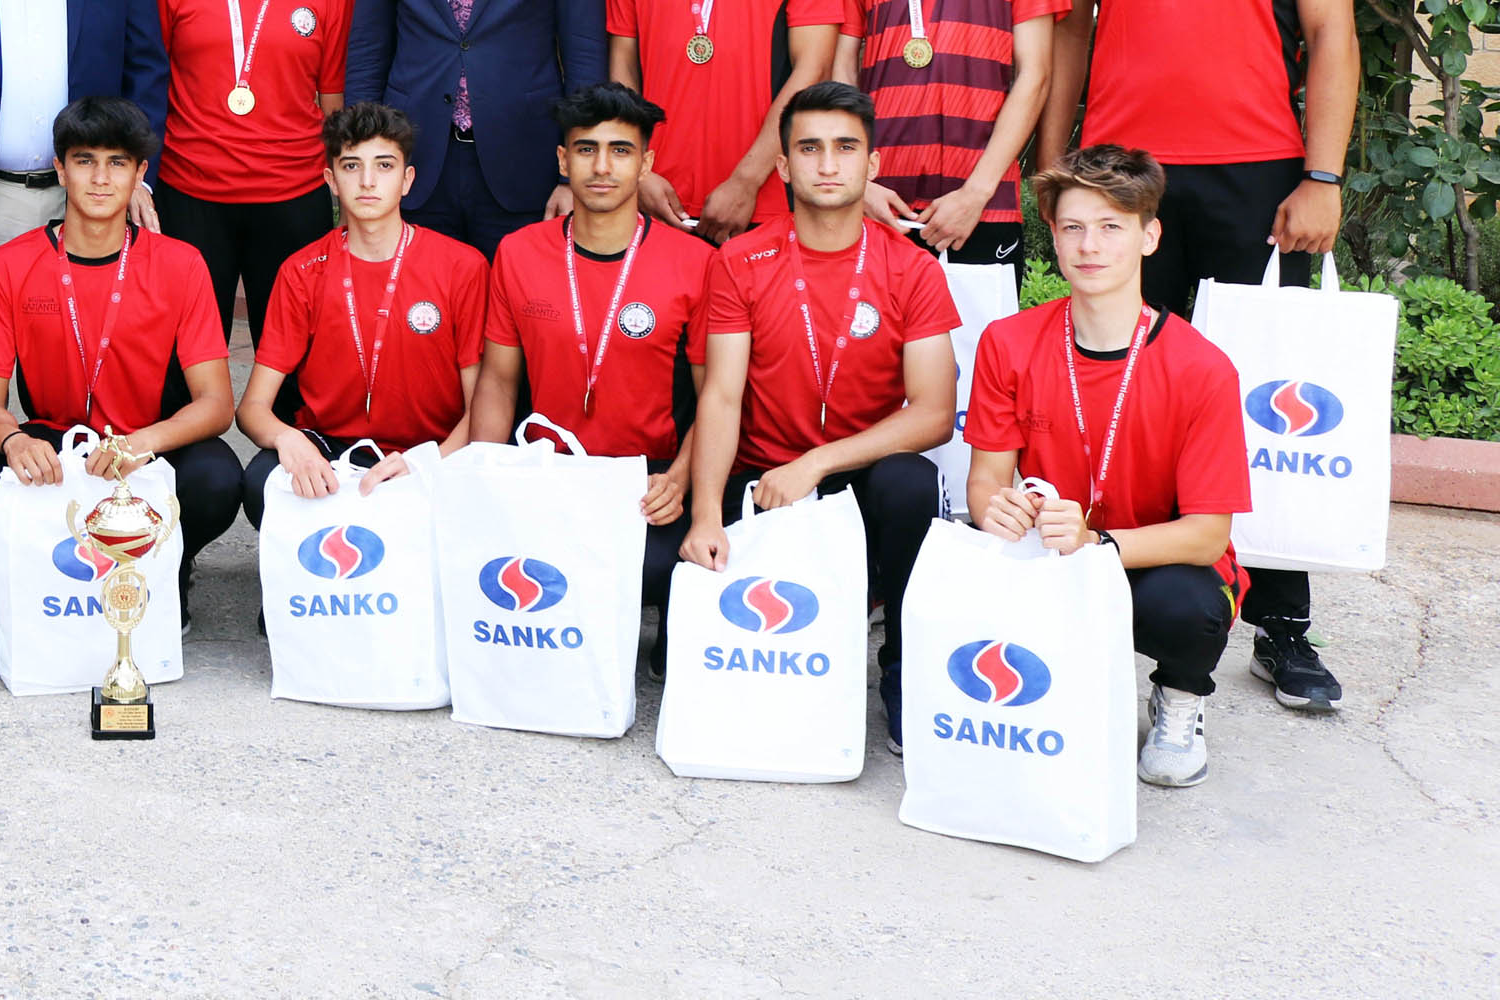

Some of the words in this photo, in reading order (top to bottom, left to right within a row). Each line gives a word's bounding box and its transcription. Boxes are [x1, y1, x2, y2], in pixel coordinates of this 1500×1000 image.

[1105, 428, 1116, 446] SPOR
[1250, 447, 1353, 479] ANKO
[288, 593, 399, 618] SANKO
[473, 620, 584, 649] SANKO
[703, 646, 831, 677] SANKO
[933, 713, 1065, 757] SANKO
